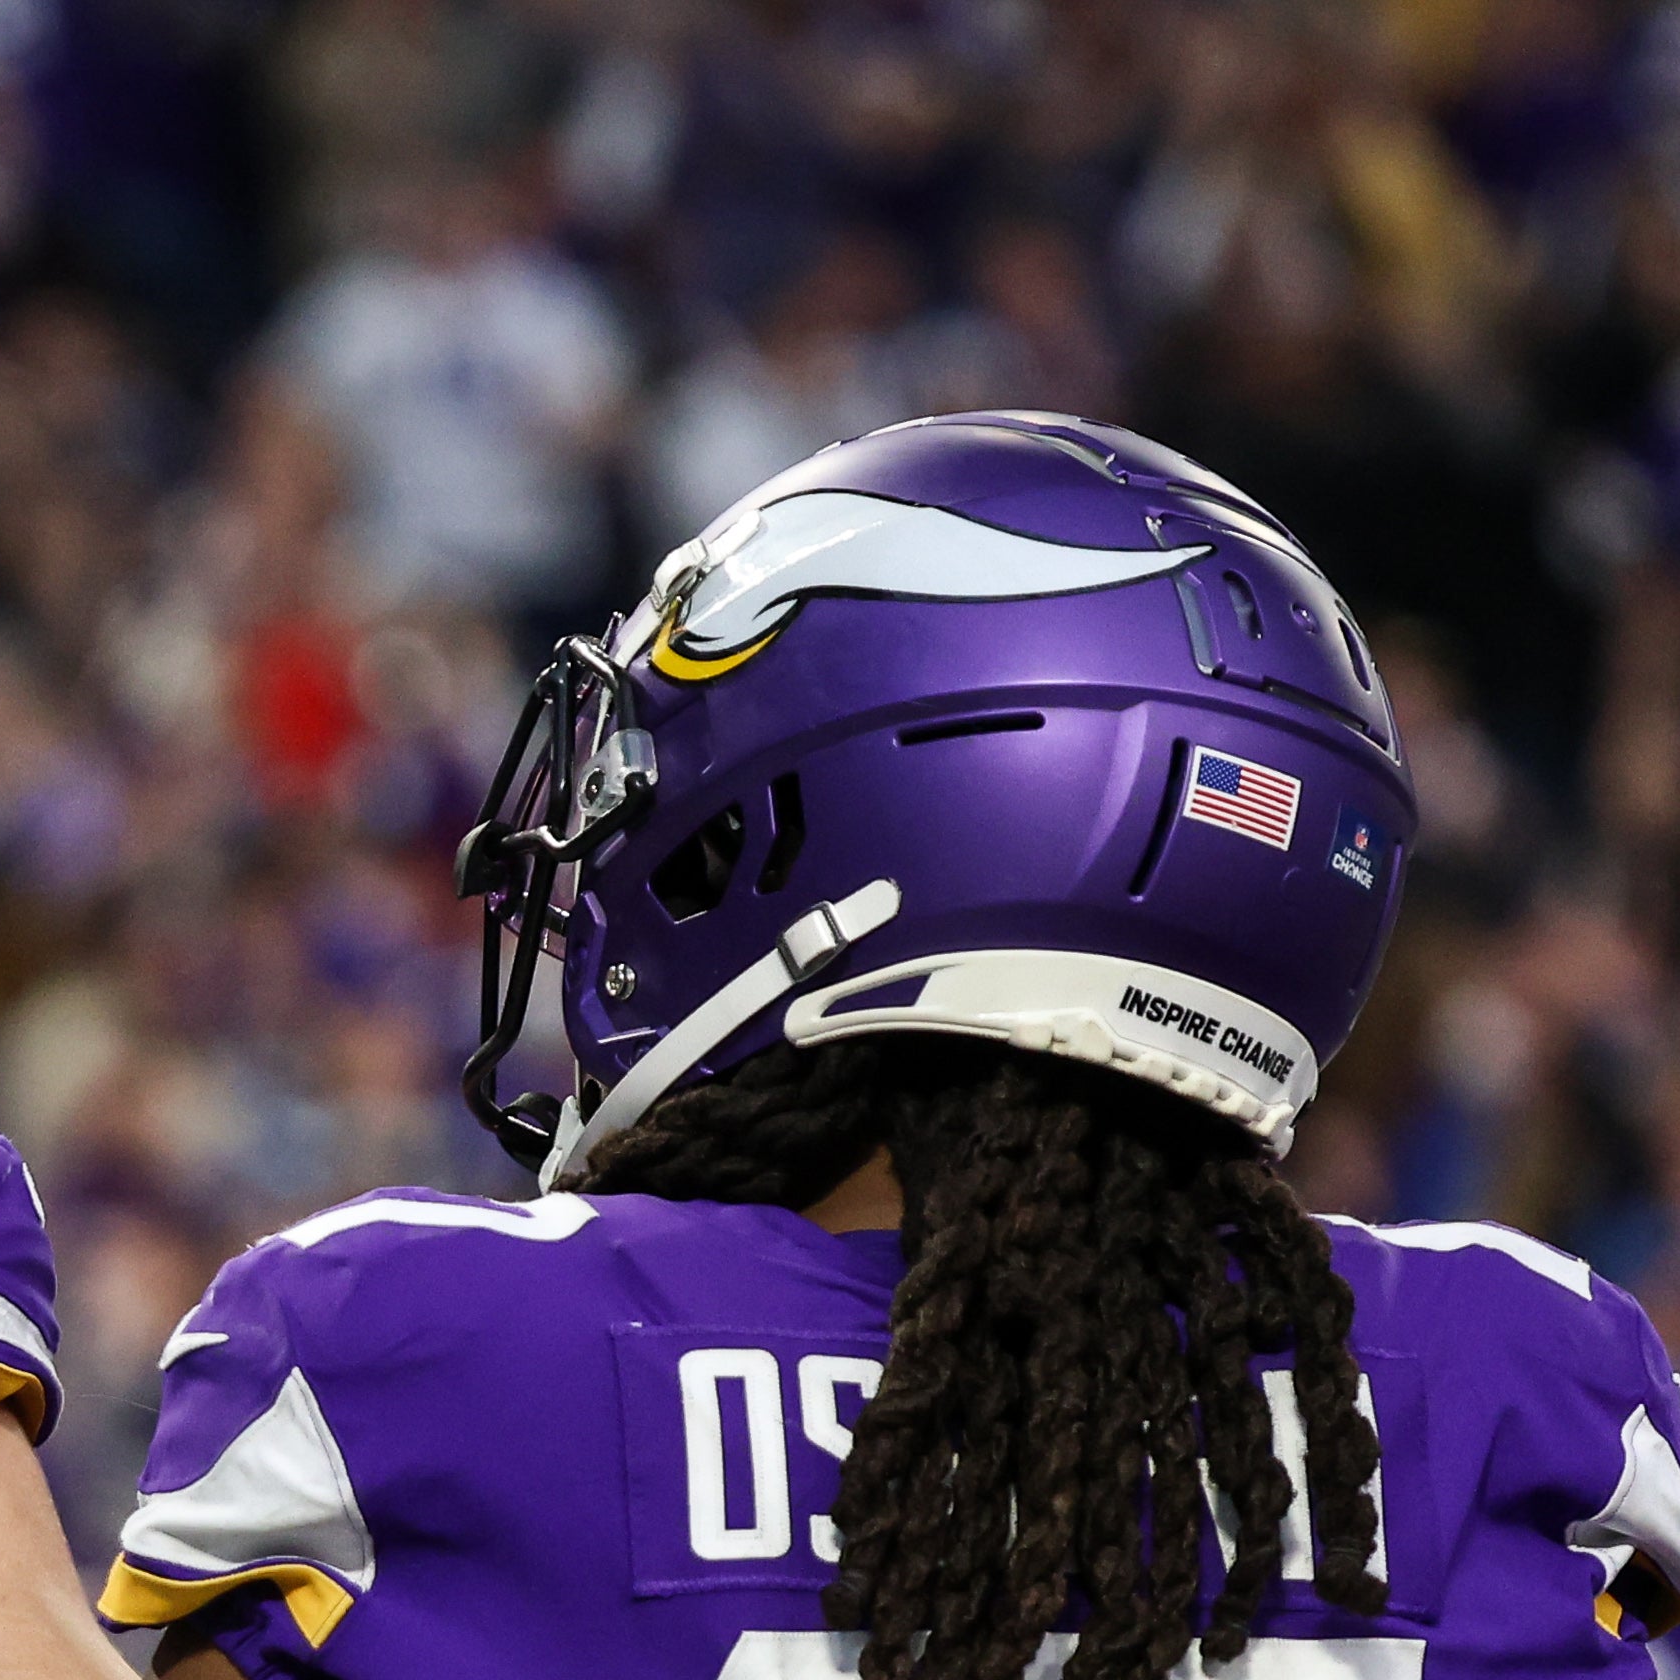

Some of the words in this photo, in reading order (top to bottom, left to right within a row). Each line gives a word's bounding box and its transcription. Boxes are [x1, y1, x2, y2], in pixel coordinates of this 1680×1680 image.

[1332, 853, 1375, 890] CHANGE
[1119, 985, 1221, 1044] INSPIRE
[1219, 1027, 1295, 1085] CHANGE
